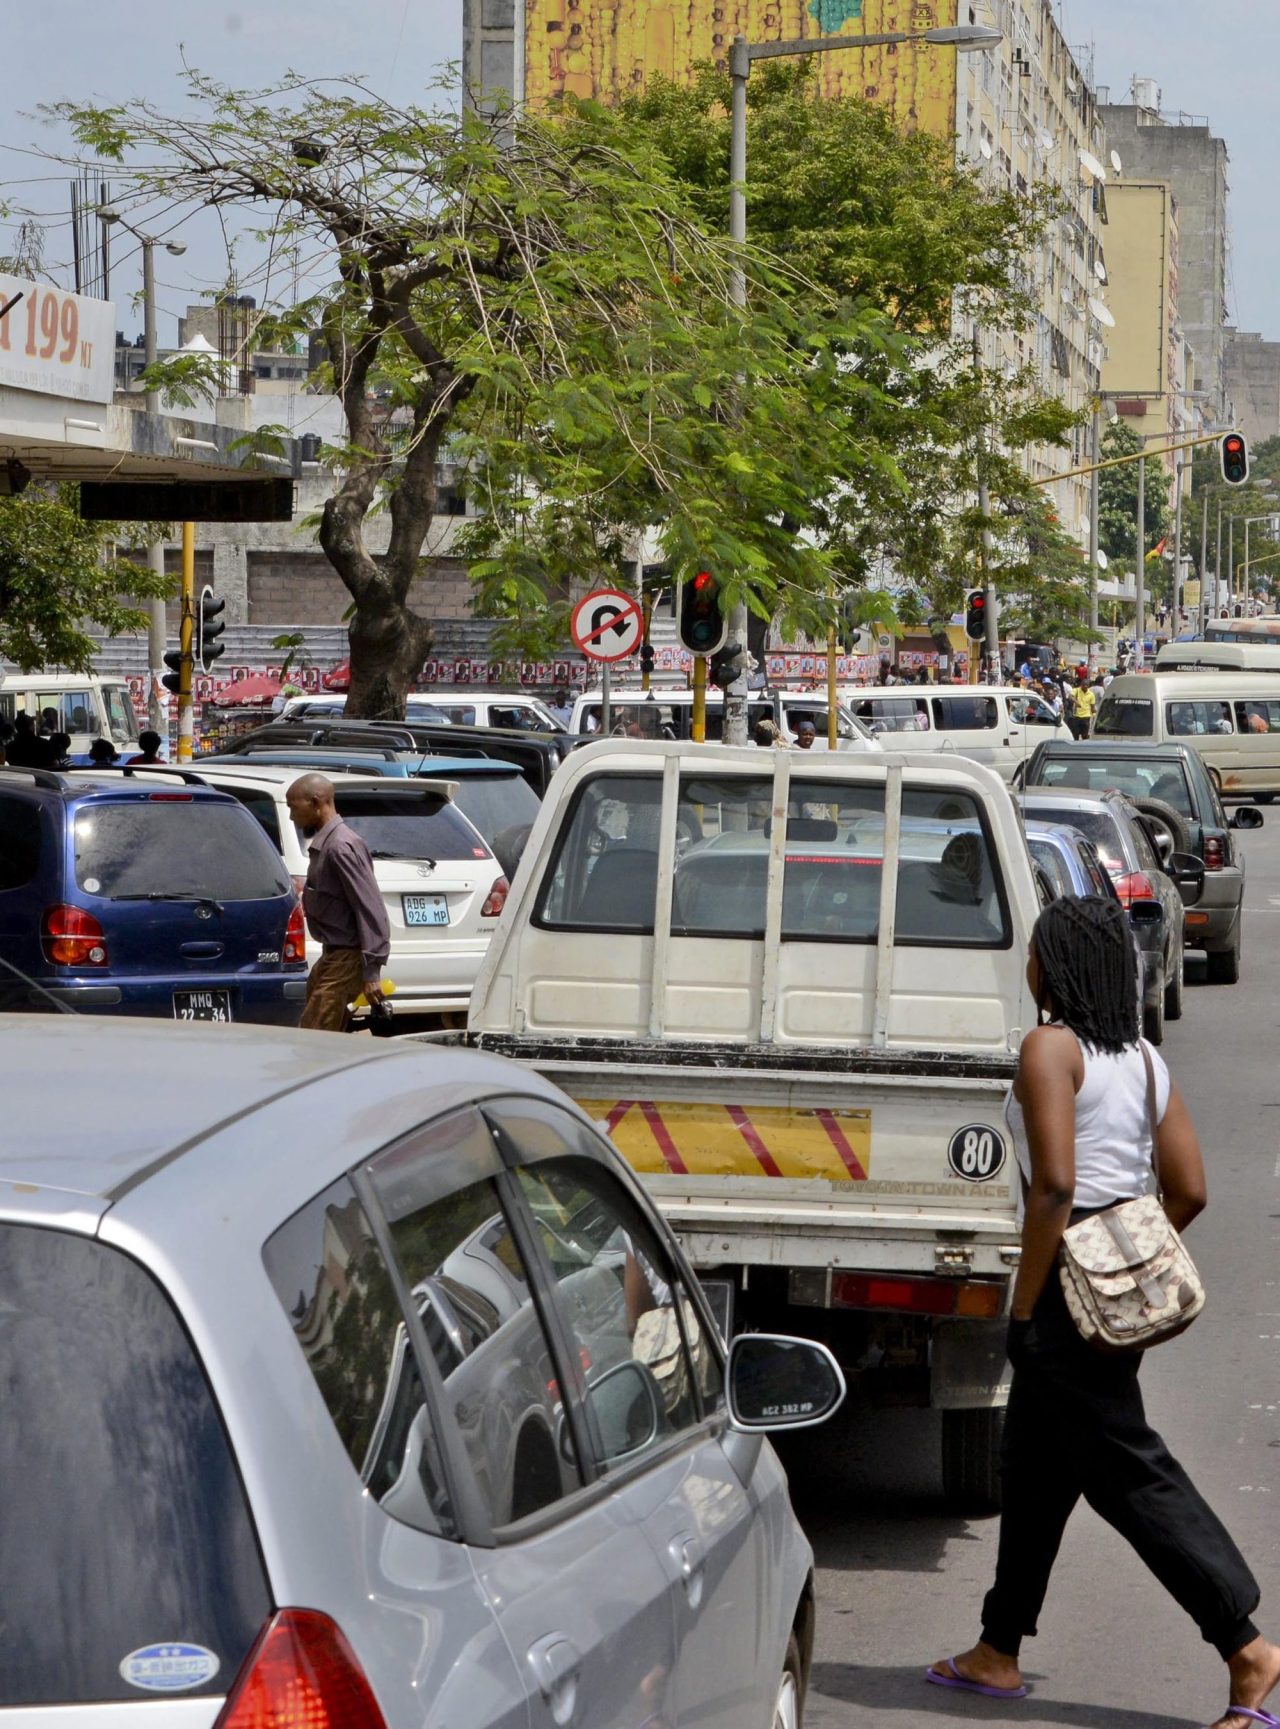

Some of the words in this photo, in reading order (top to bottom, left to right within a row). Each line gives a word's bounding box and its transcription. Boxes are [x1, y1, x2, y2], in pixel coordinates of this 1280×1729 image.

[25, 288, 79, 364] 199
[407, 898, 426, 910] ADG
[409, 911, 427, 922] 926
[434, 911, 446, 922] MP
[190, 993, 213, 1008] MMQ
[181, 1008, 195, 1021] 22
[212, 1007, 226, 1022] 34
[962, 1130, 993, 1175] 80
[968, 1184, 1010, 1199] ACE
